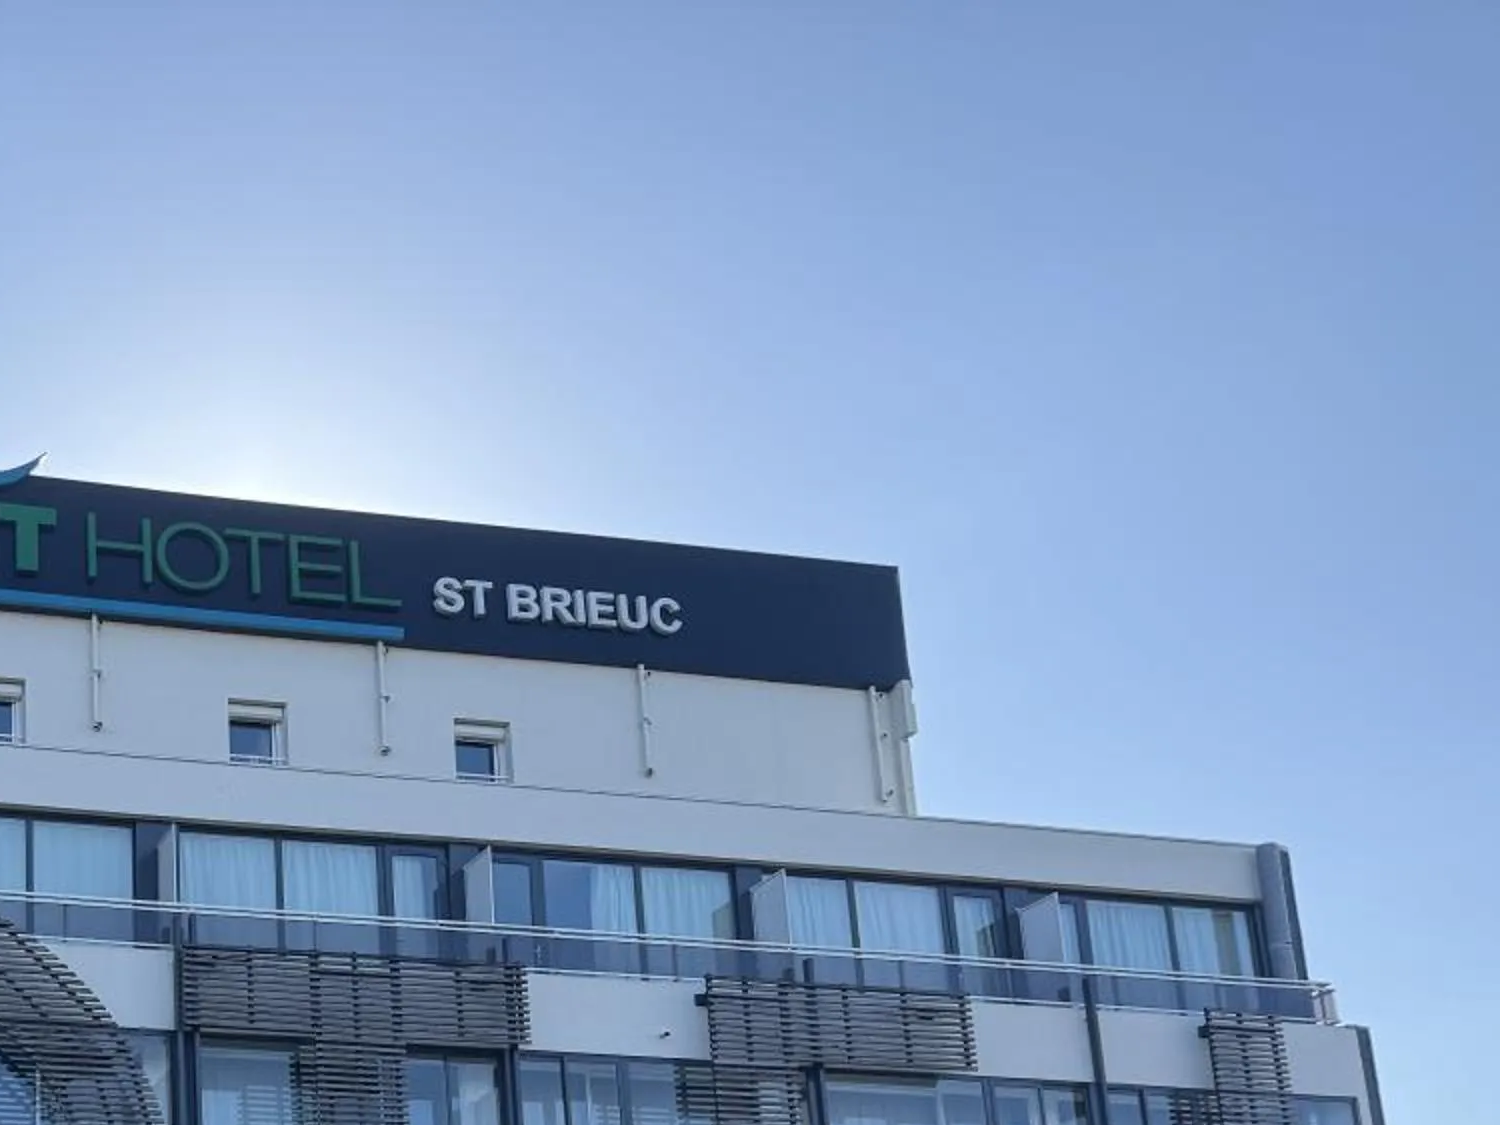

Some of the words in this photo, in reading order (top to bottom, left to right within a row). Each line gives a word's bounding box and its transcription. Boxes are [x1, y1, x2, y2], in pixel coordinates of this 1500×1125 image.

[86, 510, 403, 608] HOTEL
[433, 576, 493, 618] ST
[506, 583, 683, 635] BRIEUC
